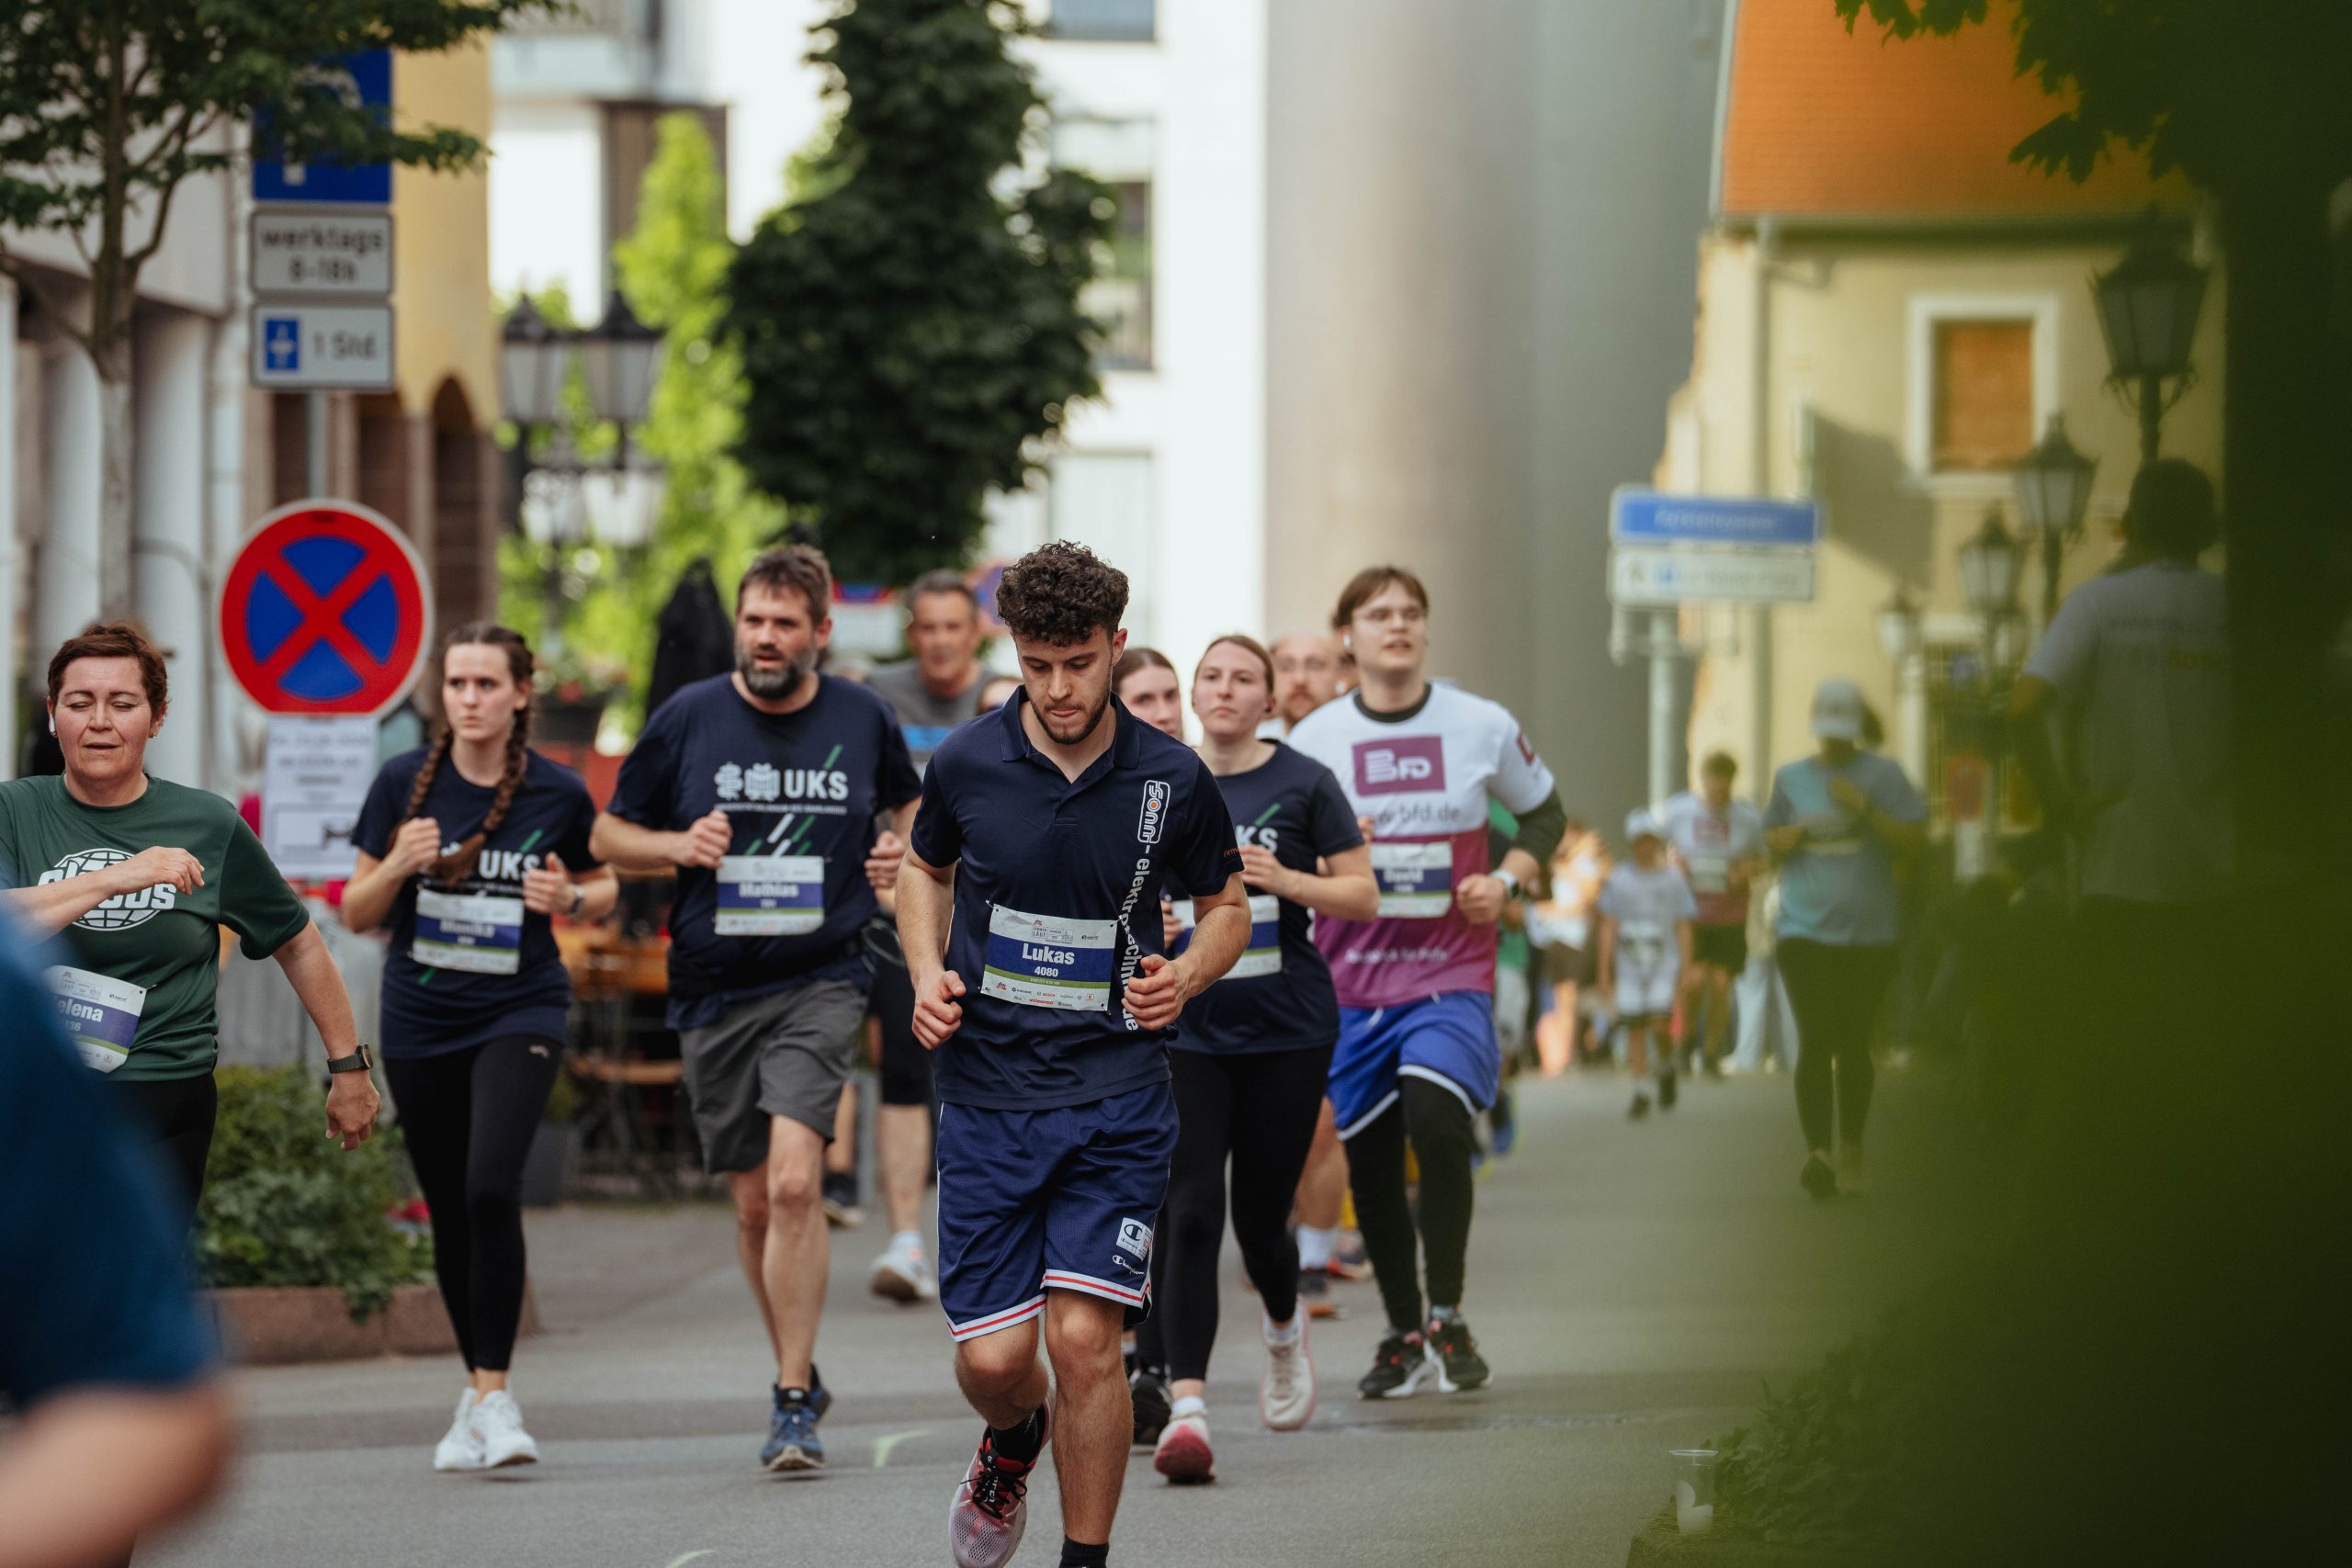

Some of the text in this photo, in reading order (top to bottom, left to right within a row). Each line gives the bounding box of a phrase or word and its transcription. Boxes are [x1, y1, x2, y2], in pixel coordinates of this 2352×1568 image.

[262, 224, 382, 256] werktags
[784, 769, 849, 800] UKS
[1235, 825, 1278, 852] KS
[479, 850, 540, 880] UKS
[1022, 942, 1075, 965] Lukas
[1035, 966, 1058, 977] 4080
[58, 998, 104, 1022] elena
